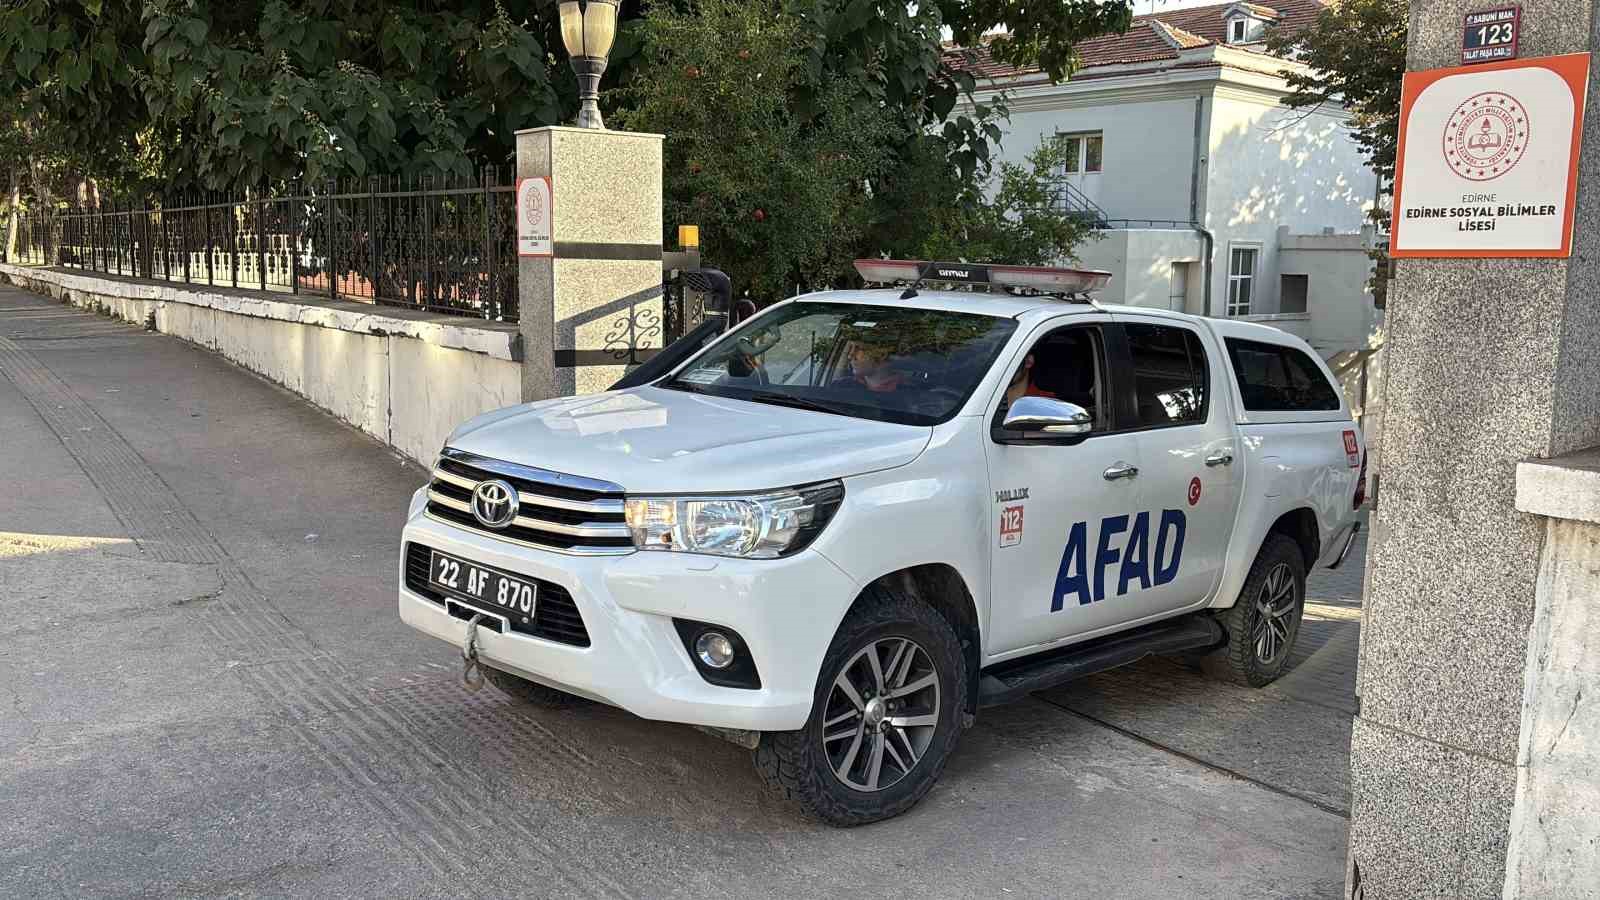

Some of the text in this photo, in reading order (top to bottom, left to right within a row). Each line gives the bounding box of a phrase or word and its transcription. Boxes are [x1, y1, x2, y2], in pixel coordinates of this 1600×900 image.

[1478, 22, 1513, 46] 123
[1462, 193, 1497, 204] EDİRNE
[1406, 203, 1556, 219] EDİRNE SOSYAL BİLİMLER
[1458, 218, 1496, 232] LİSESİ
[1002, 510, 1020, 531] 112
[1050, 509, 1187, 613] AFAD
[438, 558, 532, 613] 22 AF 870
